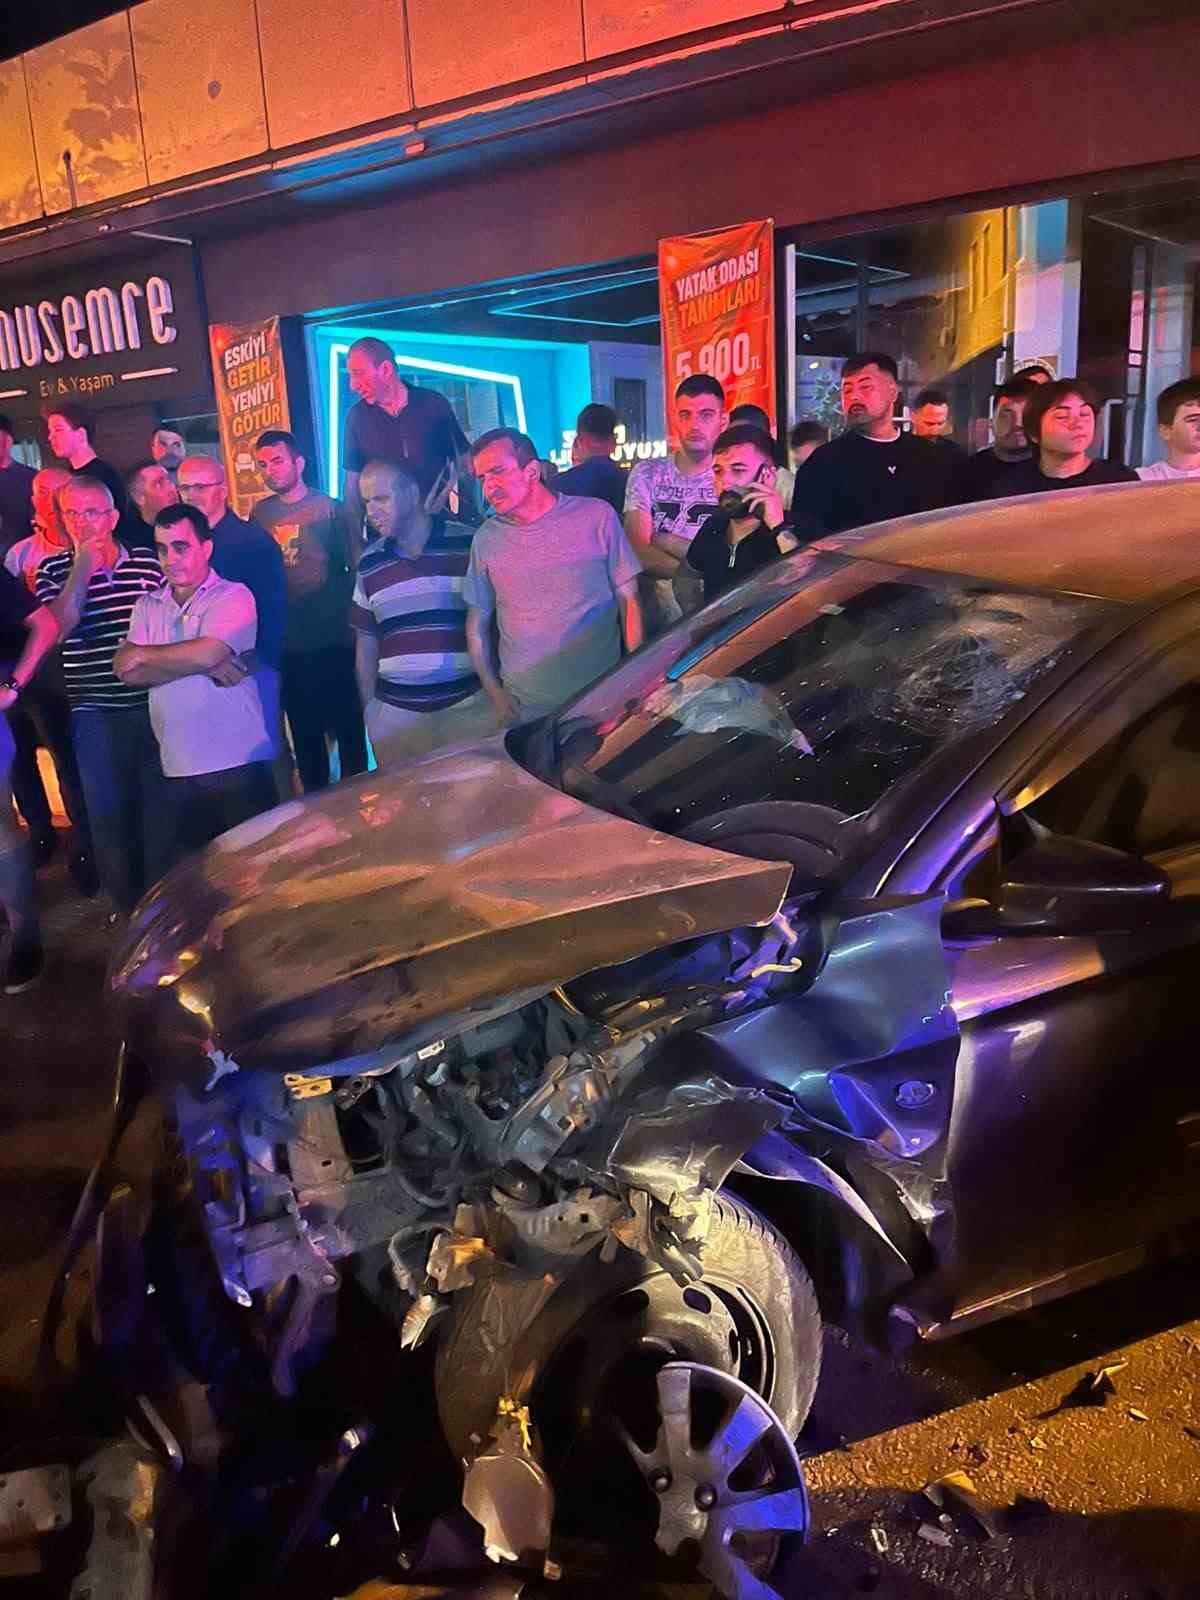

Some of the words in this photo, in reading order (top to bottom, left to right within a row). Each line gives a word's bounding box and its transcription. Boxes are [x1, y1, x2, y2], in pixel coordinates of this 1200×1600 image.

[676, 264, 719, 302] YATAK
[719, 248, 760, 281] ODASI
[57, 376, 70, 395] &
[232, 403, 281, 438] GÖTÜR
